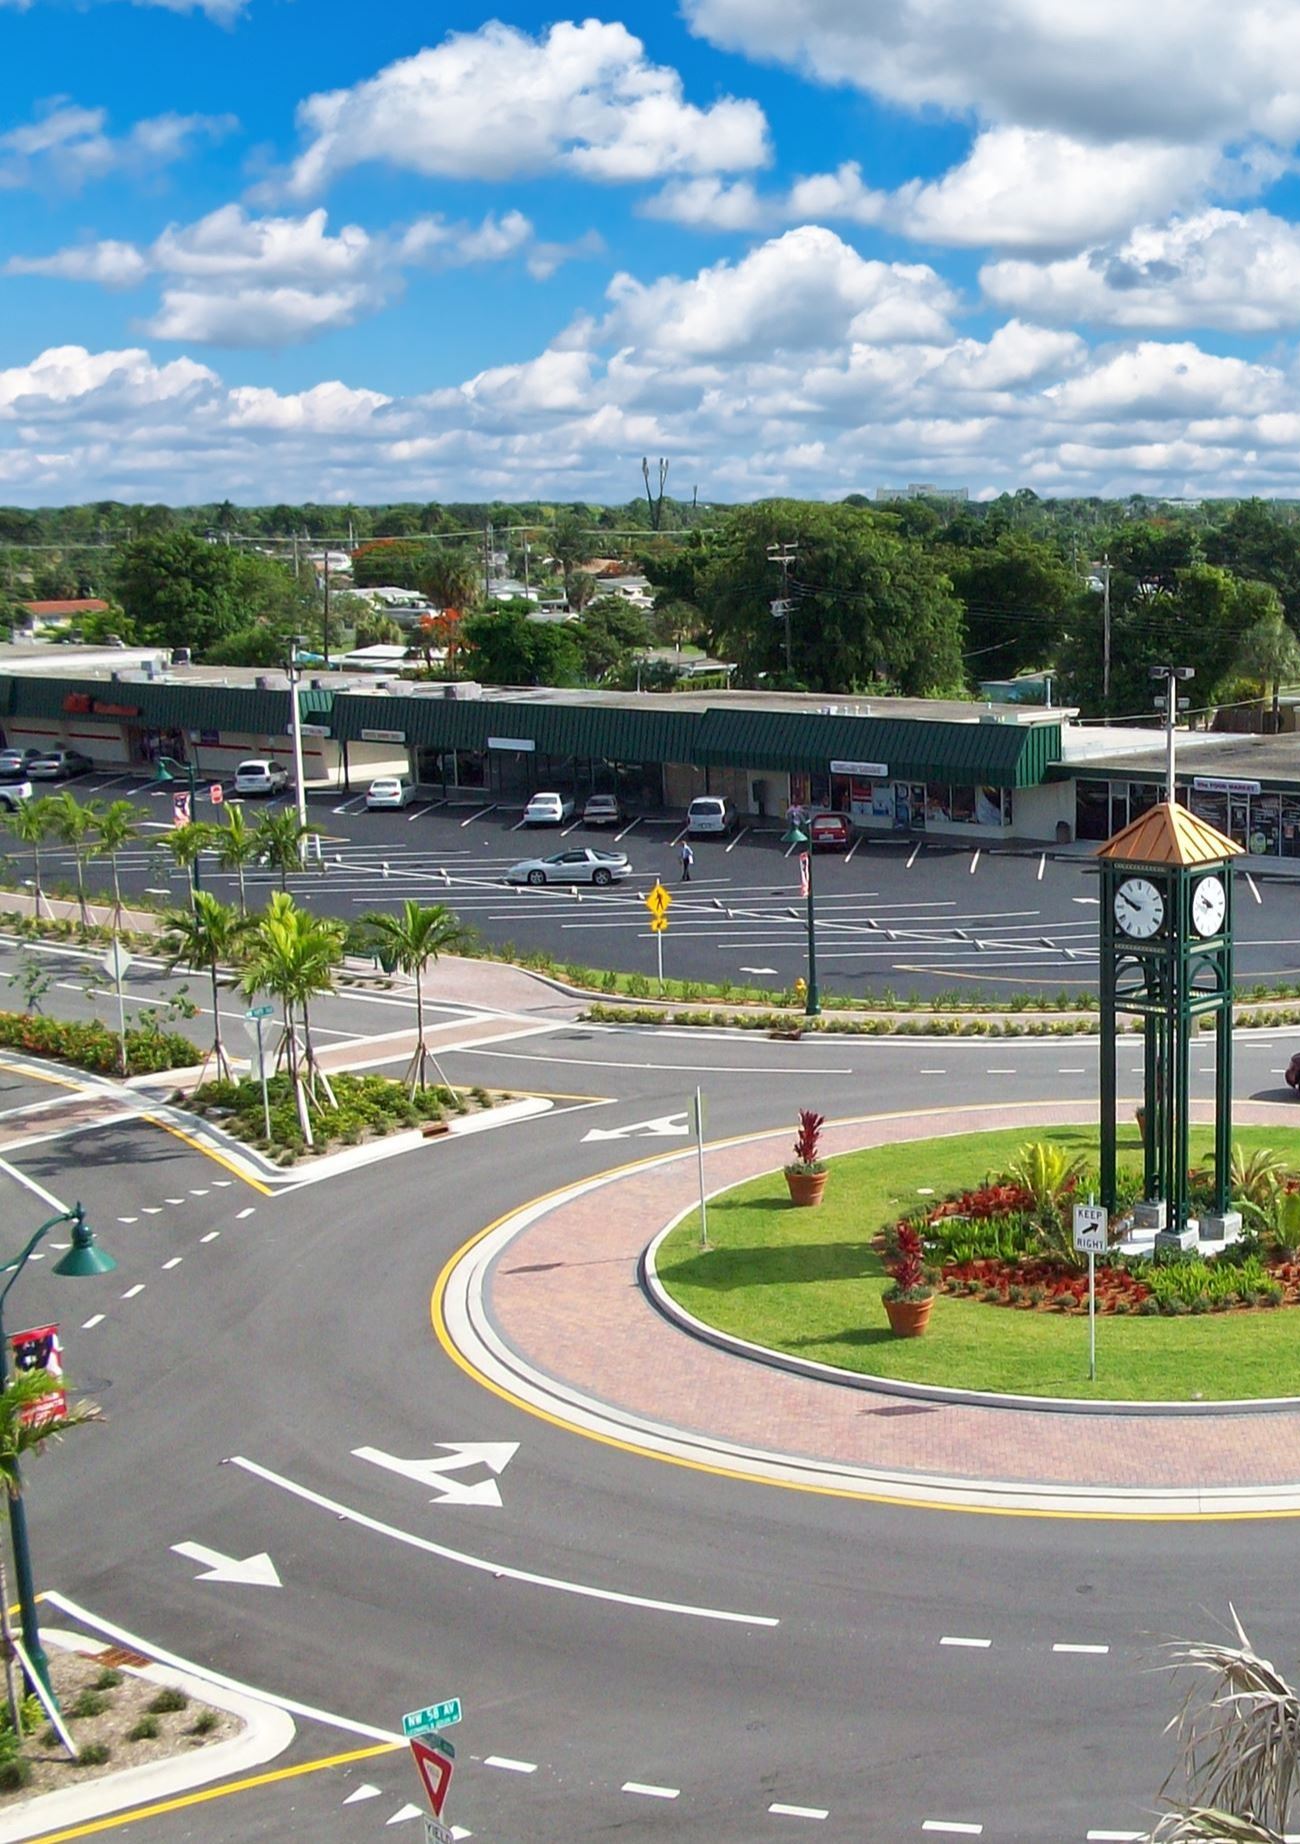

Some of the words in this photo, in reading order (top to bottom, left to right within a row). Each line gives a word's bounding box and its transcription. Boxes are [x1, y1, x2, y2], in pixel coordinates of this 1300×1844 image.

[1078, 1210, 1102, 1219] KEEP
[1077, 1238, 1103, 1249] RIGHT
[407, 1712, 422, 1727] NW
[443, 1702, 455, 1716] AV
